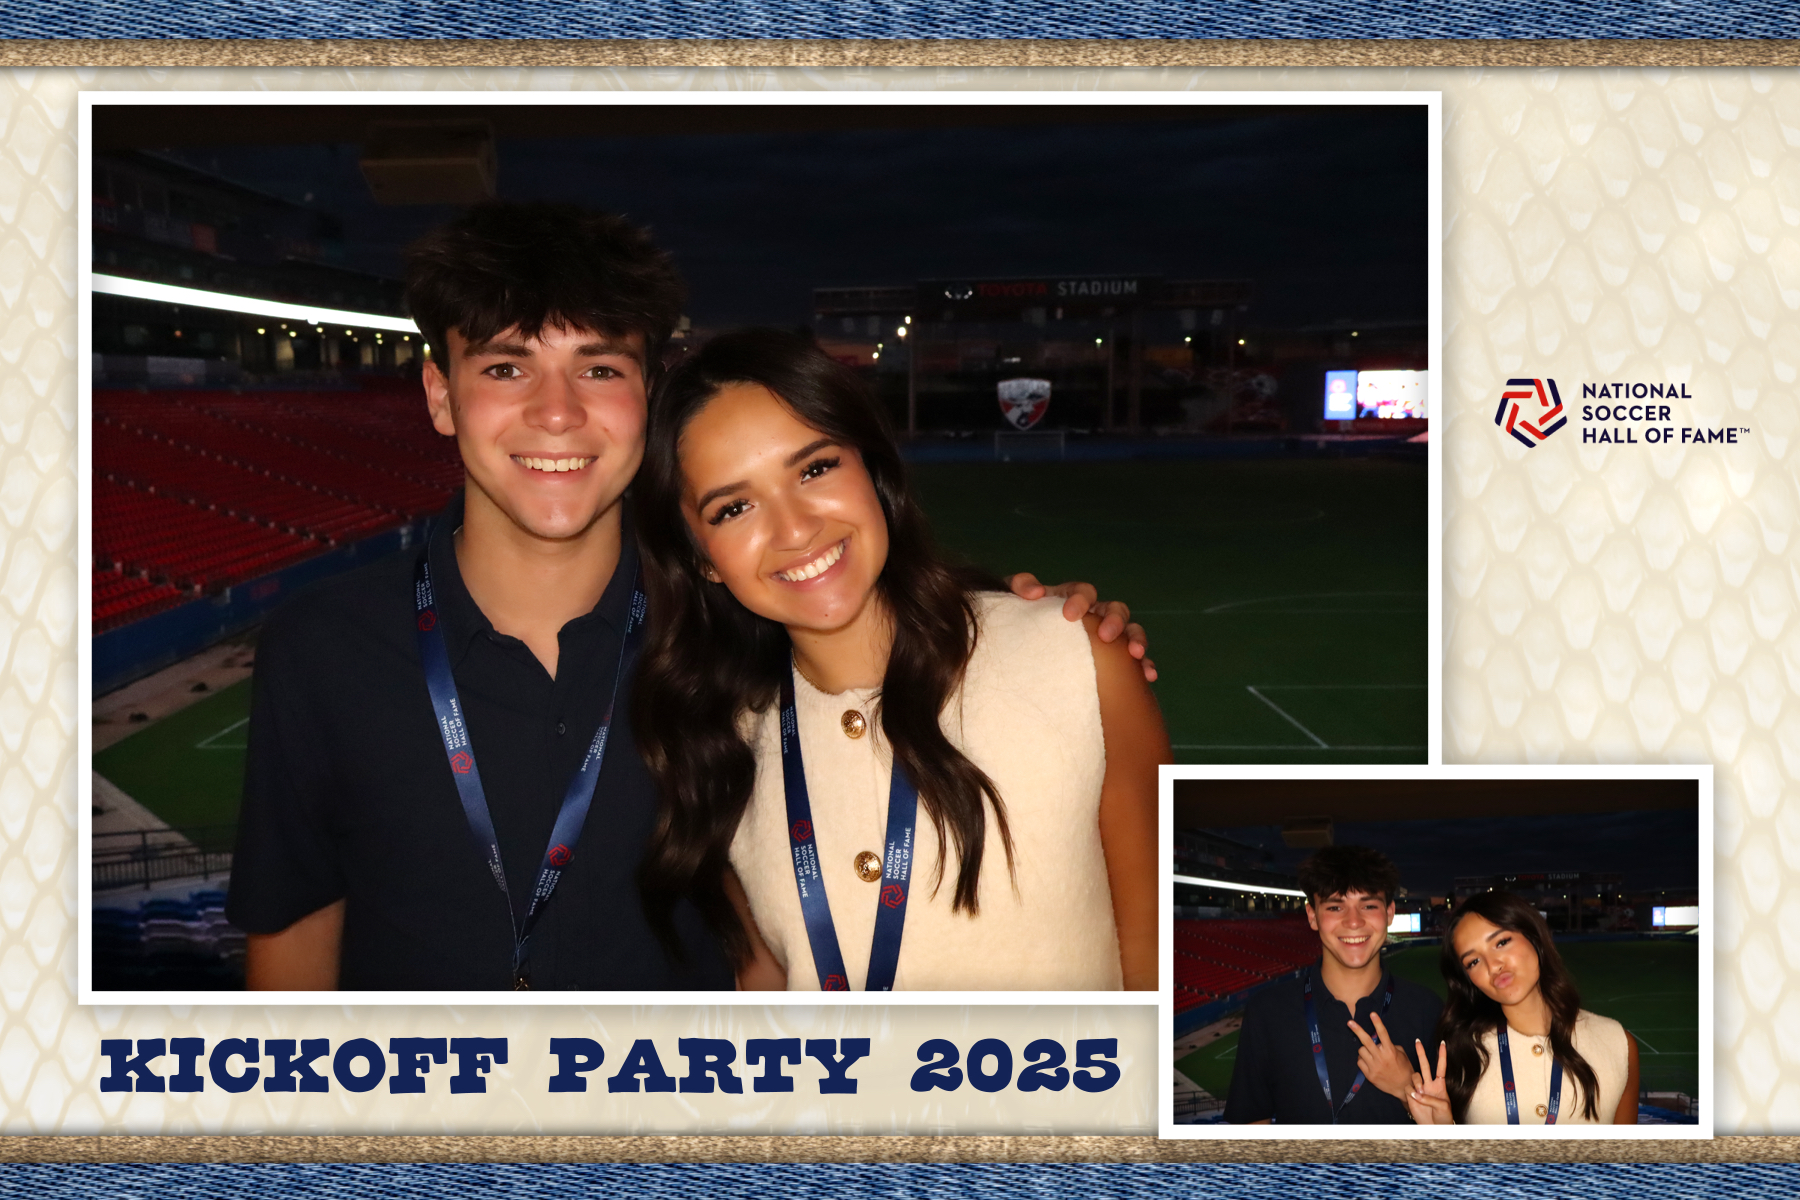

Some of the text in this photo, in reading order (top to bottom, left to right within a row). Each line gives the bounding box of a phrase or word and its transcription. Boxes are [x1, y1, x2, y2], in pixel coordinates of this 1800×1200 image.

[976, 280, 1138, 297] TOYOTA STADIUM
[425, 580, 430, 588] OF
[631, 608, 636, 616] OF
[636, 592, 644, 618] SOCCER
[441, 716, 454, 750] NATIONAL
[448, 720, 460, 748] SOCCER
[450, 698, 468, 746] HALL OF FAME
[782, 728, 788, 736] OF
[589, 744, 594, 754] OF
[592, 726, 603, 754] SOCCER
[596, 726, 608, 760] NATIONAL
[581, 754, 591, 772] FAME
[904, 828, 912, 848] FAME
[800, 846, 810, 875] SOCCER
[808, 844, 818, 880] NATIONAL
[886, 841, 895, 879] NATIONAL
[893, 848, 902, 880] SOCCER
[902, 849, 910, 860] OF
[541, 870, 556, 896] SOCCER
[798, 867, 804, 877] OF
[529, 868, 549, 916] HALL OF FAME
[544, 870, 562, 902] NATIONAL
[800, 878, 808, 898] FAME
